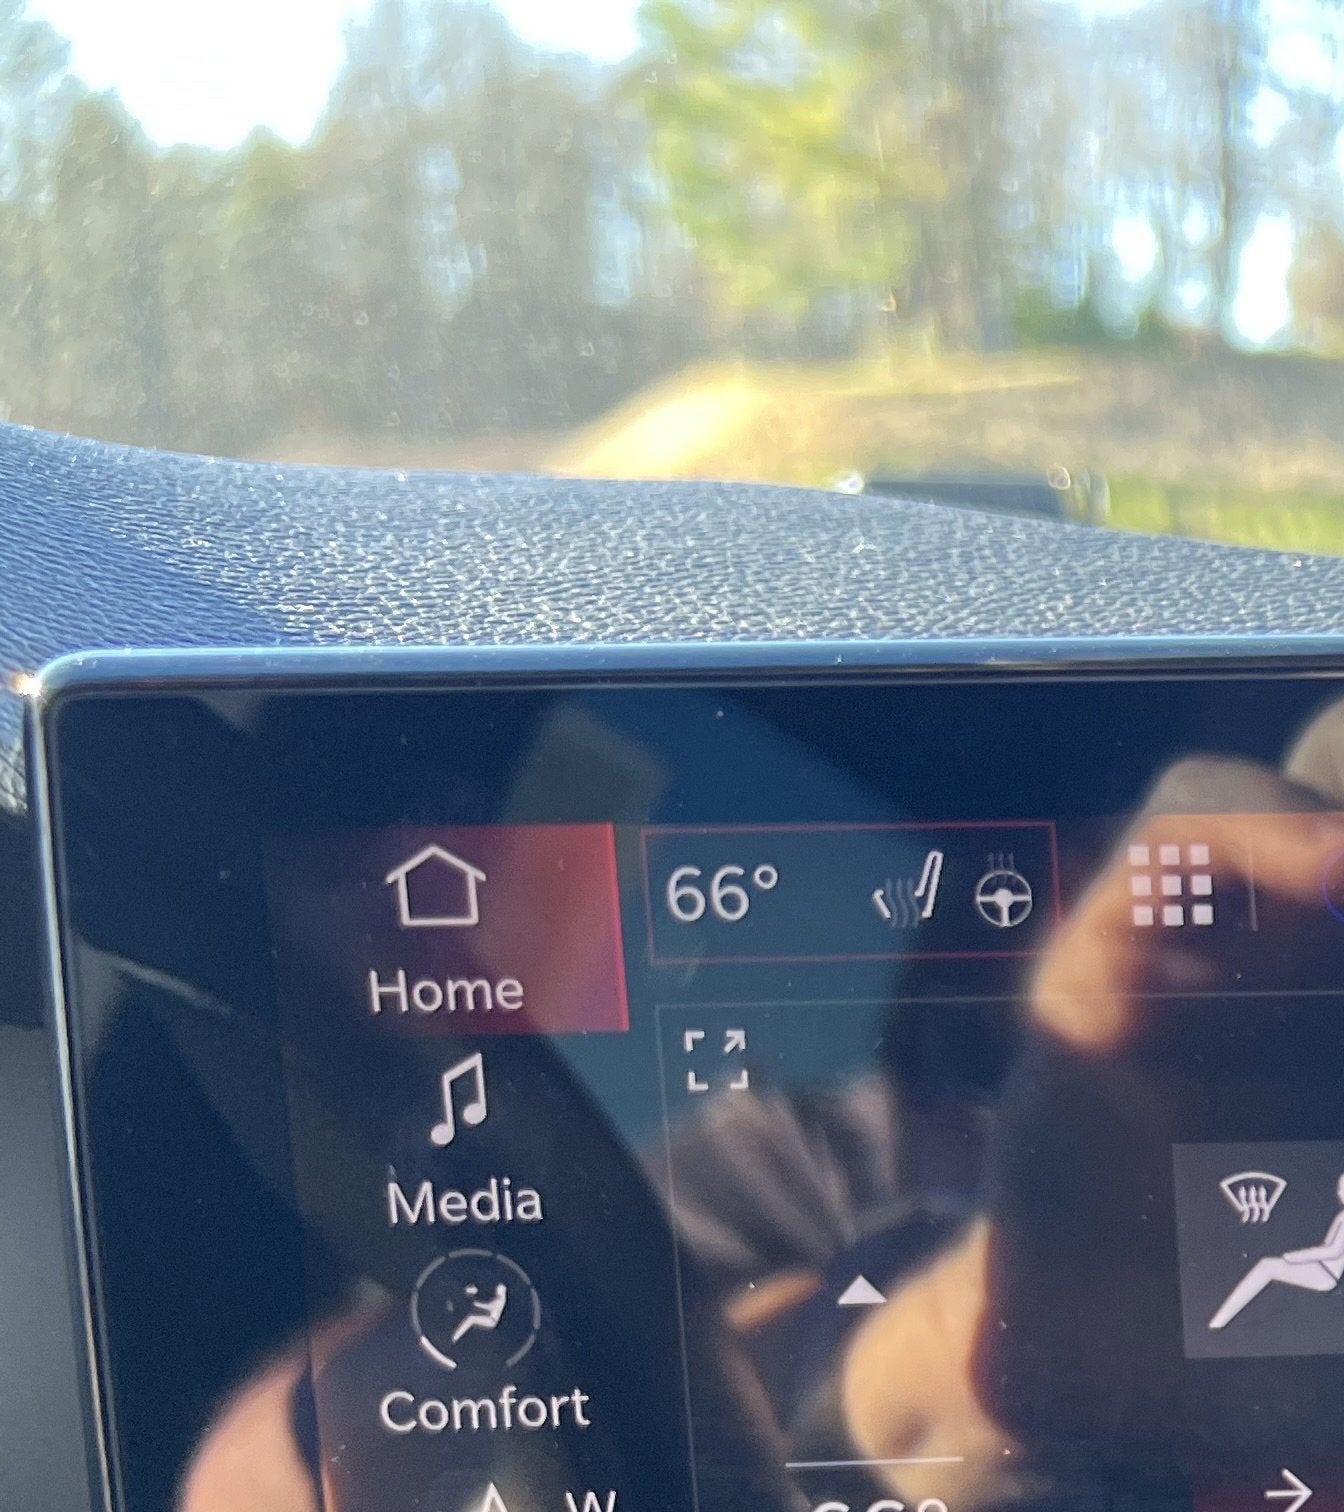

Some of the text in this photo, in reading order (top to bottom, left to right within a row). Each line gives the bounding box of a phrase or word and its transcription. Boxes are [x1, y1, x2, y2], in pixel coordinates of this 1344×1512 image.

[368, 969, 524, 1013] Home
[387, 1178, 542, 1225] Media
[380, 1386, 590, 1433] Comfort
